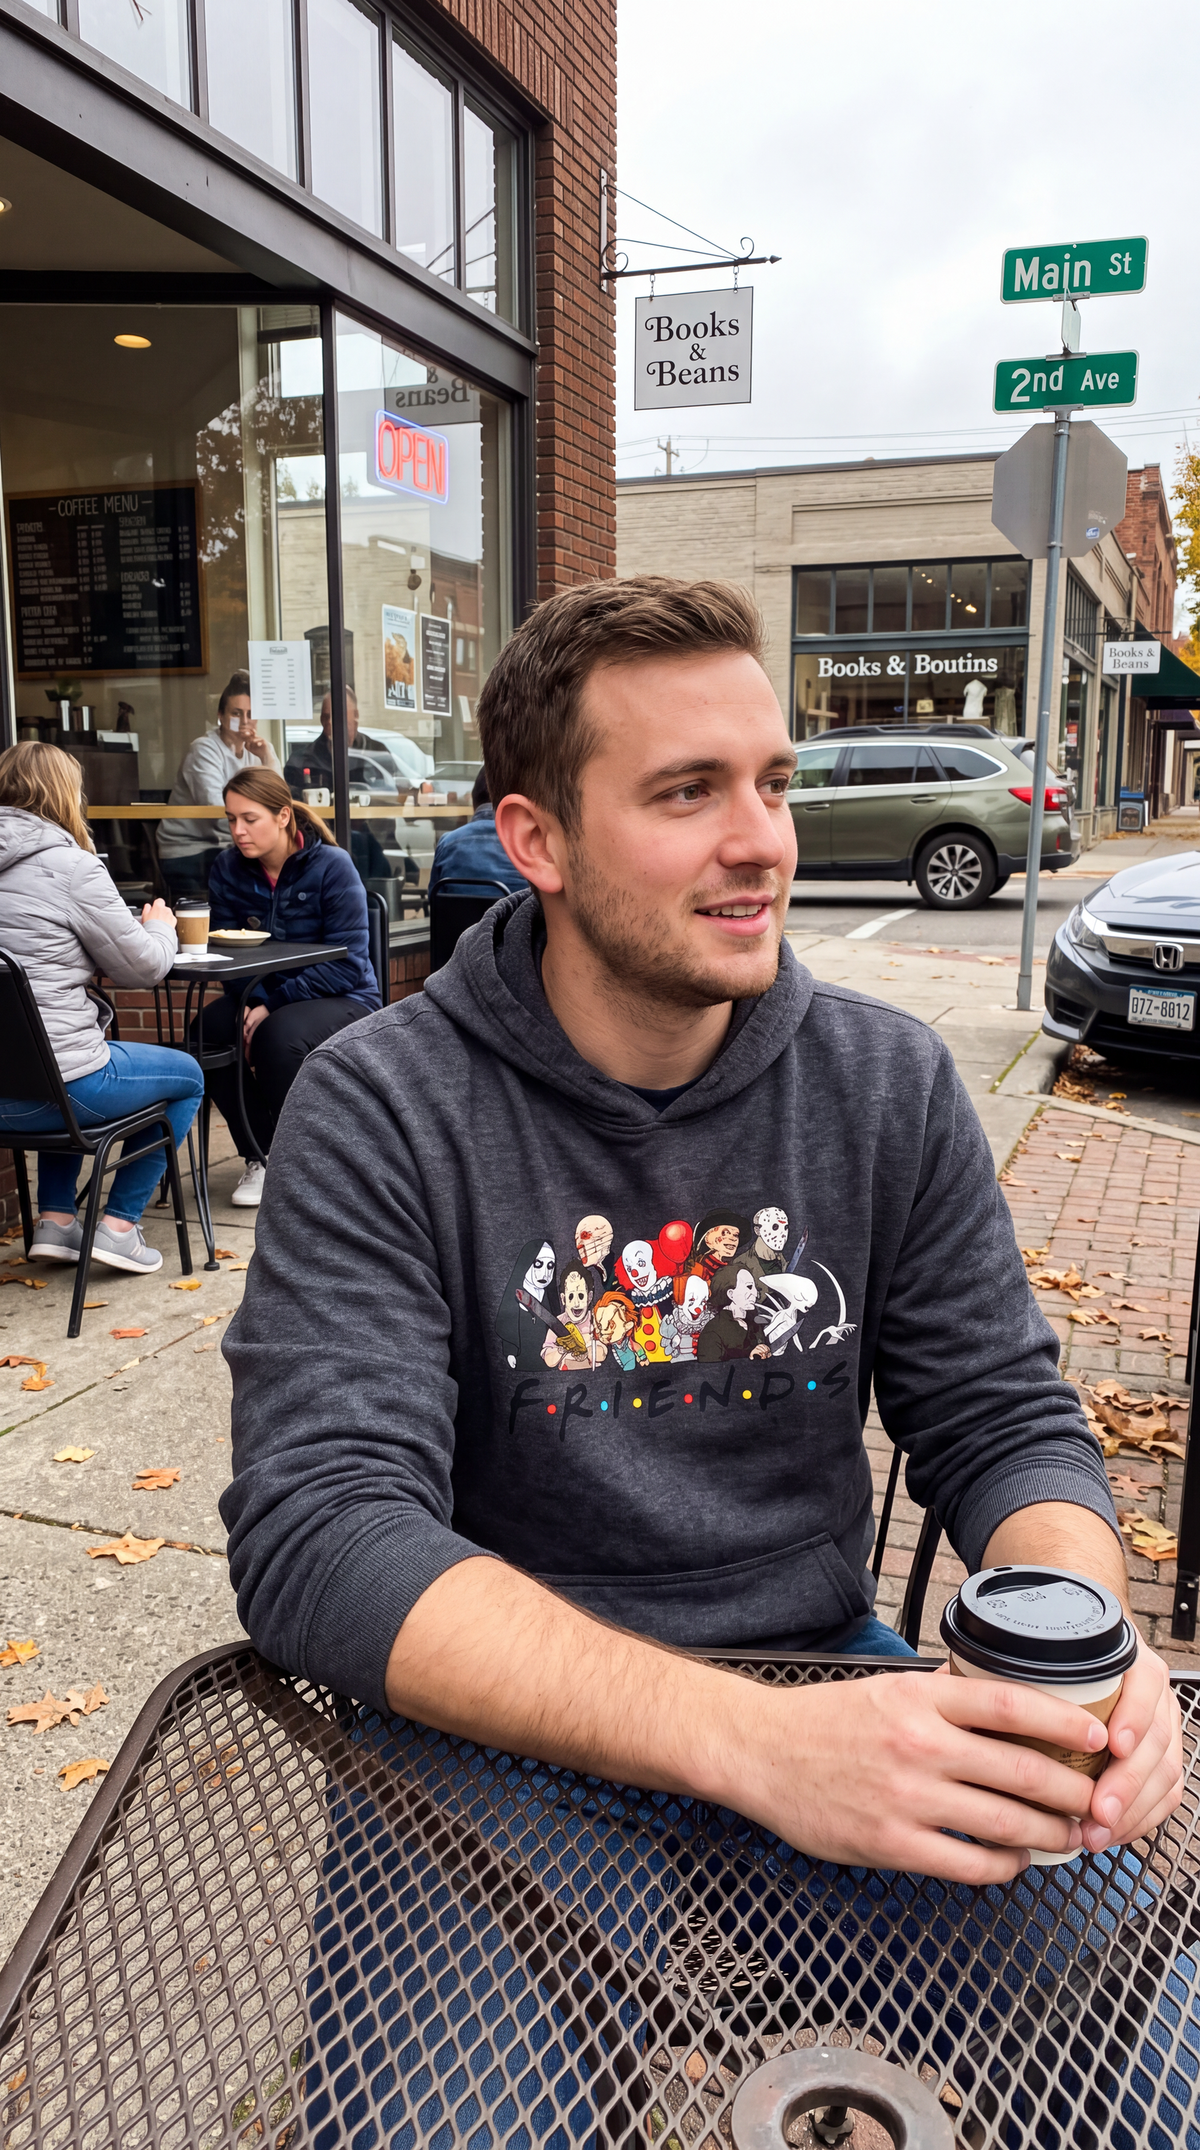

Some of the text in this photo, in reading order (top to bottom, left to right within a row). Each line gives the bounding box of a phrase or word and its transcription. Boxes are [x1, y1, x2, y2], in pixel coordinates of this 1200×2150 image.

[1014, 252, 1132, 292] Main St
[644, 311, 740, 342] Books
[689, 343, 707, 361] &
[646, 360, 740, 387] Beans
[1010, 365, 1120, 403] 2nd Ave
[378, 420, 445, 495] OPEN
[57, 494, 139, 517] COFFEE MENU
[818, 652, 998, 677] Books & Boutins
[1109, 647, 1155, 658] Books &
[1112, 659, 1149, 669] Beans
